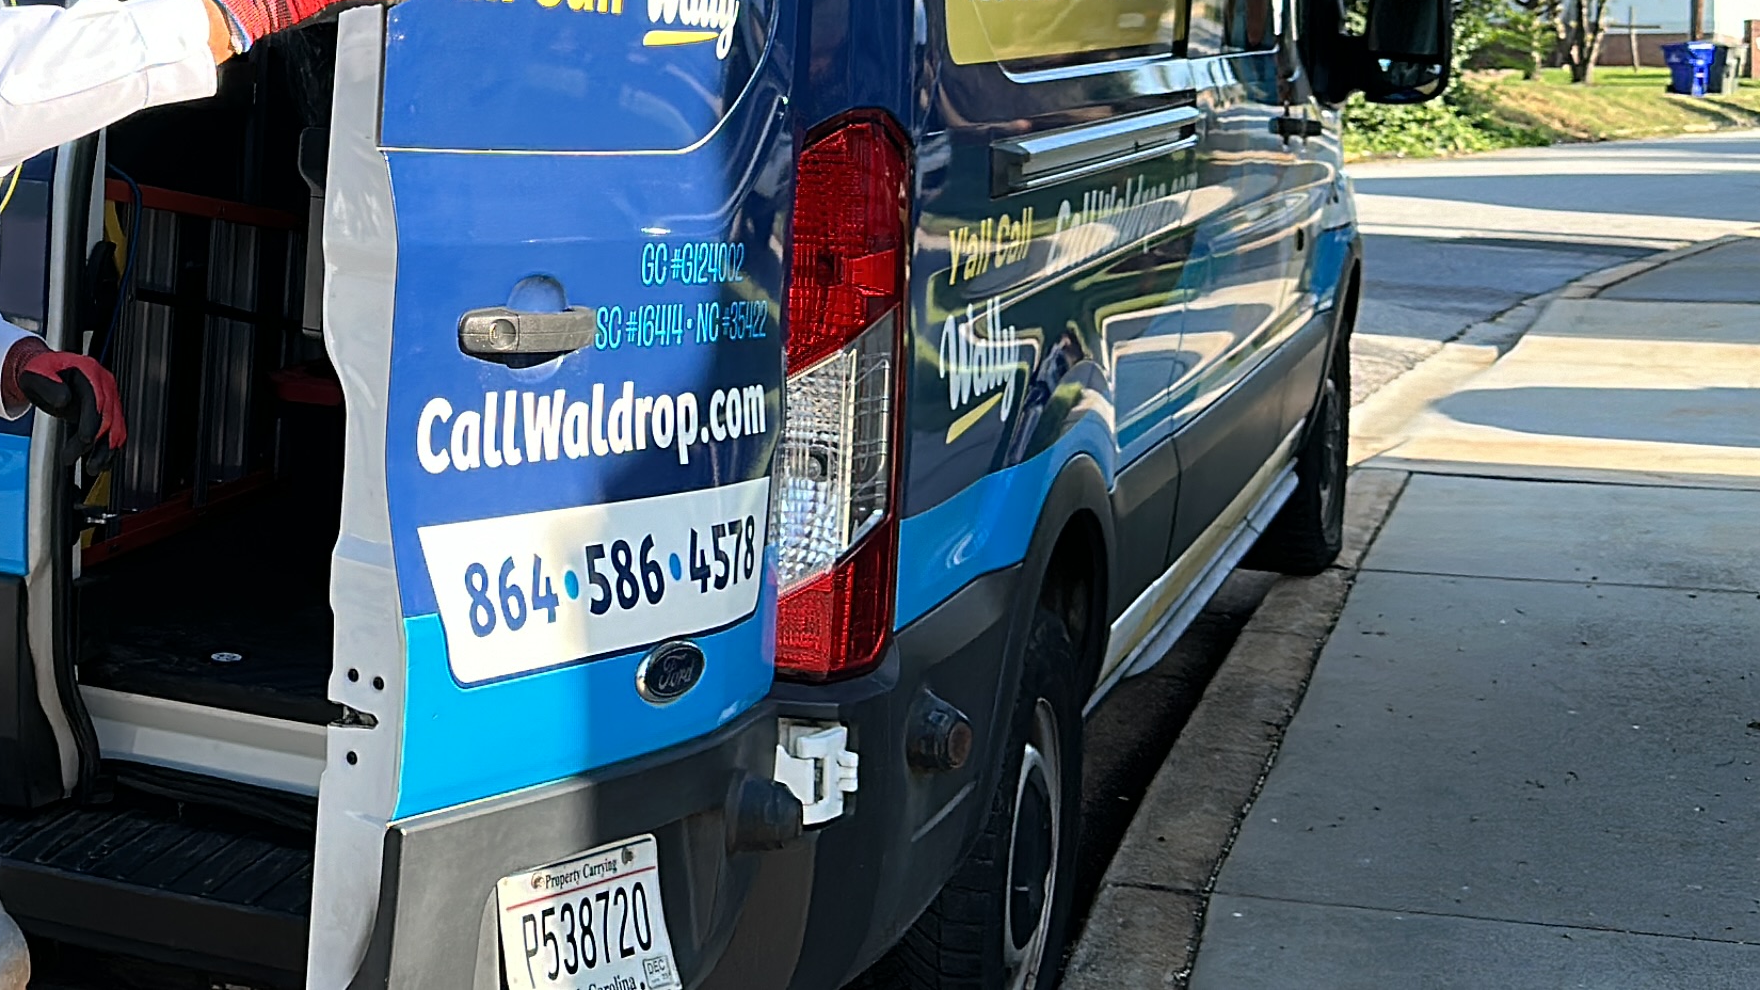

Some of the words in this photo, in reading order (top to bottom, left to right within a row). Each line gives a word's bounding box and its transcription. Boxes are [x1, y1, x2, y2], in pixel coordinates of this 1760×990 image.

[641, 242, 668, 285] GC
[949, 217, 992, 285] Y'all
[995, 206, 1033, 268] Call
[595, 305, 622, 350] SC
[625, 303, 684, 347] #16414
[696, 302, 719, 345] NC
[939, 295, 1020, 422] Wally
[416, 380, 766, 474] CallWaldrop.com
[658, 652, 696, 691] Ford
[545, 869, 581, 889] Property
[583, 858, 618, 878] Carrying
[522, 882, 652, 989] P538720
[647, 959, 667, 975] DEC
